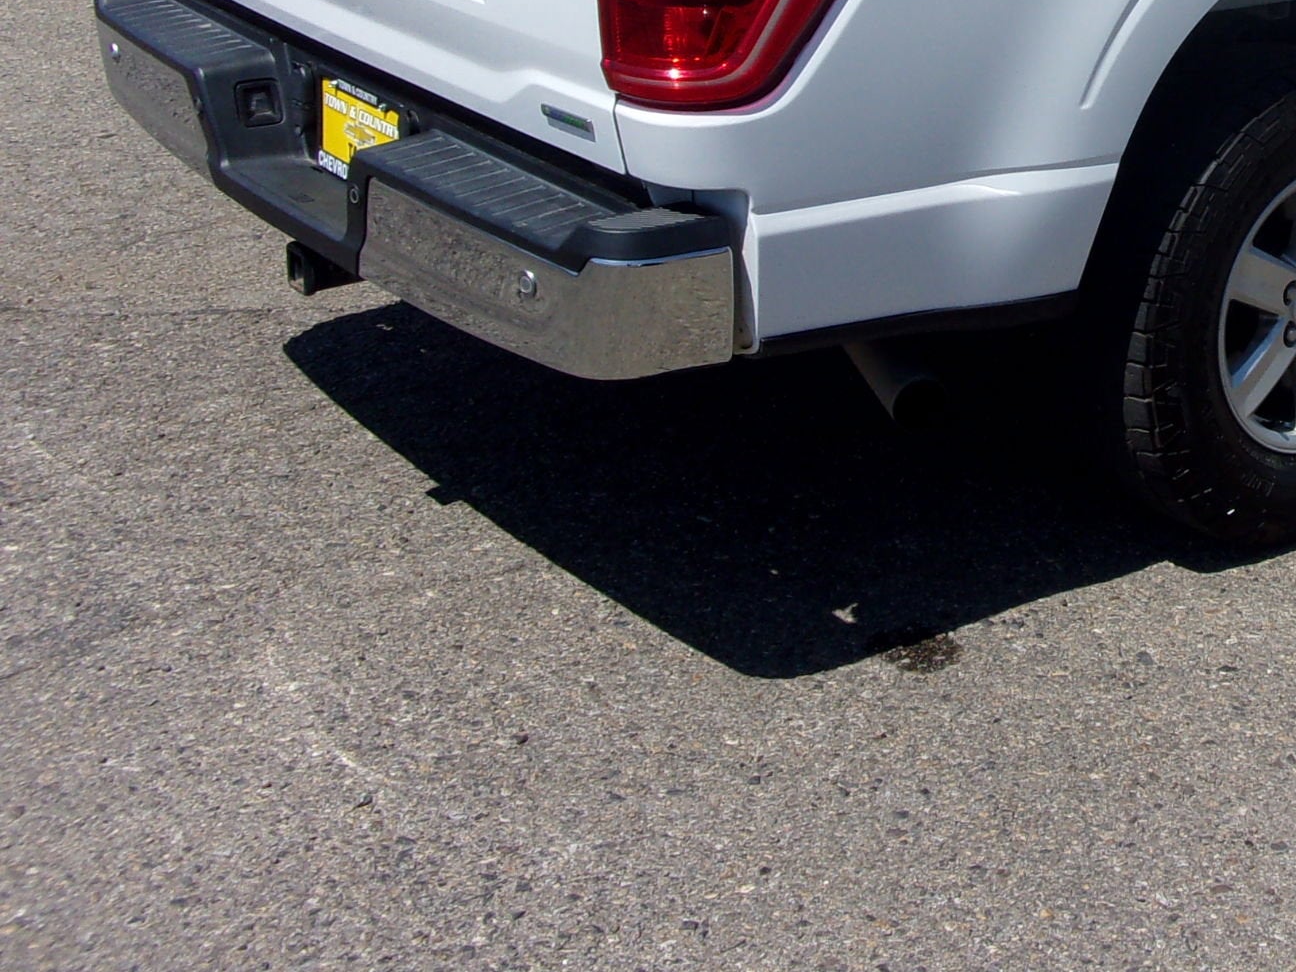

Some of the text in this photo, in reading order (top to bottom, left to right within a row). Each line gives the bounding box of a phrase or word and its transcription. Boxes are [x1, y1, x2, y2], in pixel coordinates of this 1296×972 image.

[323, 92, 399, 140] TOWN & COUNTRY
[318, 149, 349, 180] CHEVRO
